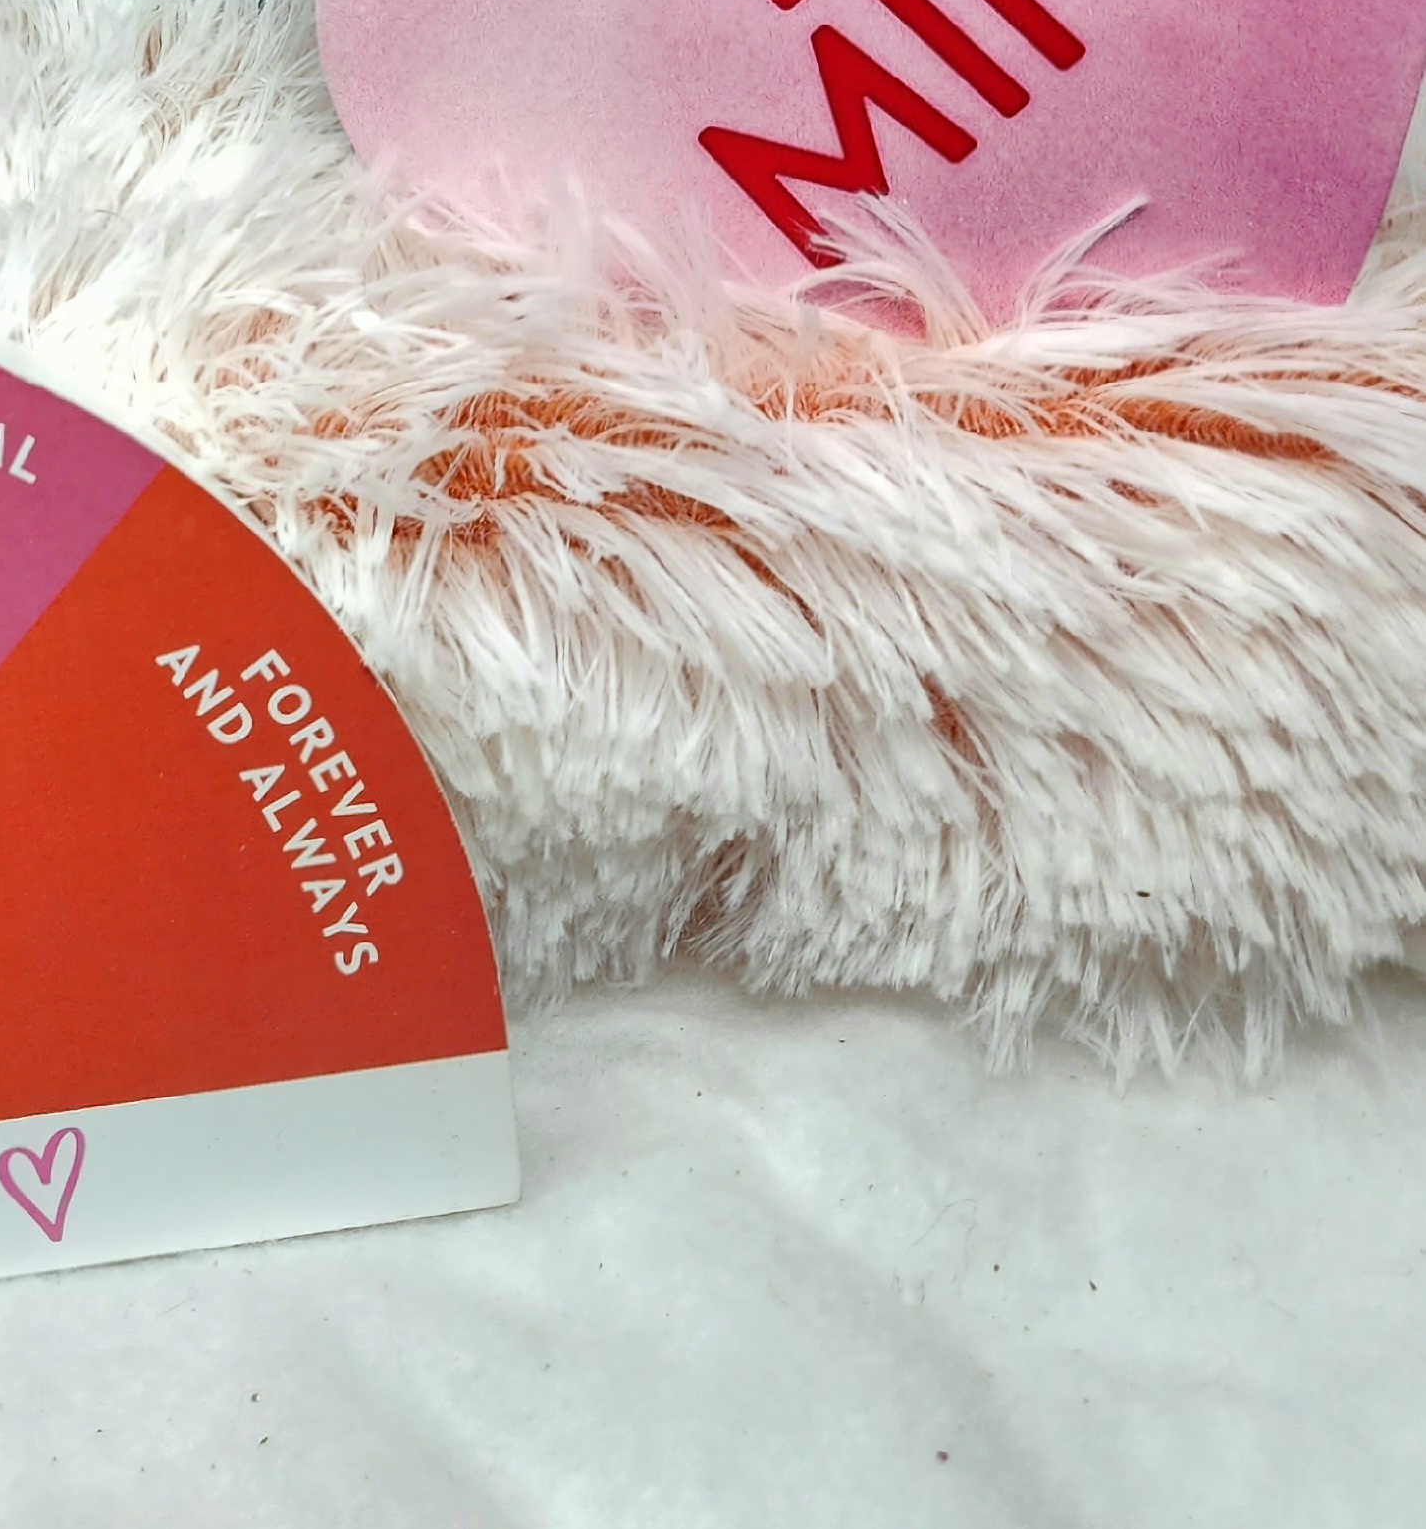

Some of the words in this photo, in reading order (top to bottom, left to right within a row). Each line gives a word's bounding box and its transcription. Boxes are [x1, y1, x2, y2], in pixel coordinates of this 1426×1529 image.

[155, 645, 252, 745] AND
[239, 765, 378, 976] ALWAYS
[241, 648, 402, 893] FOREVER
